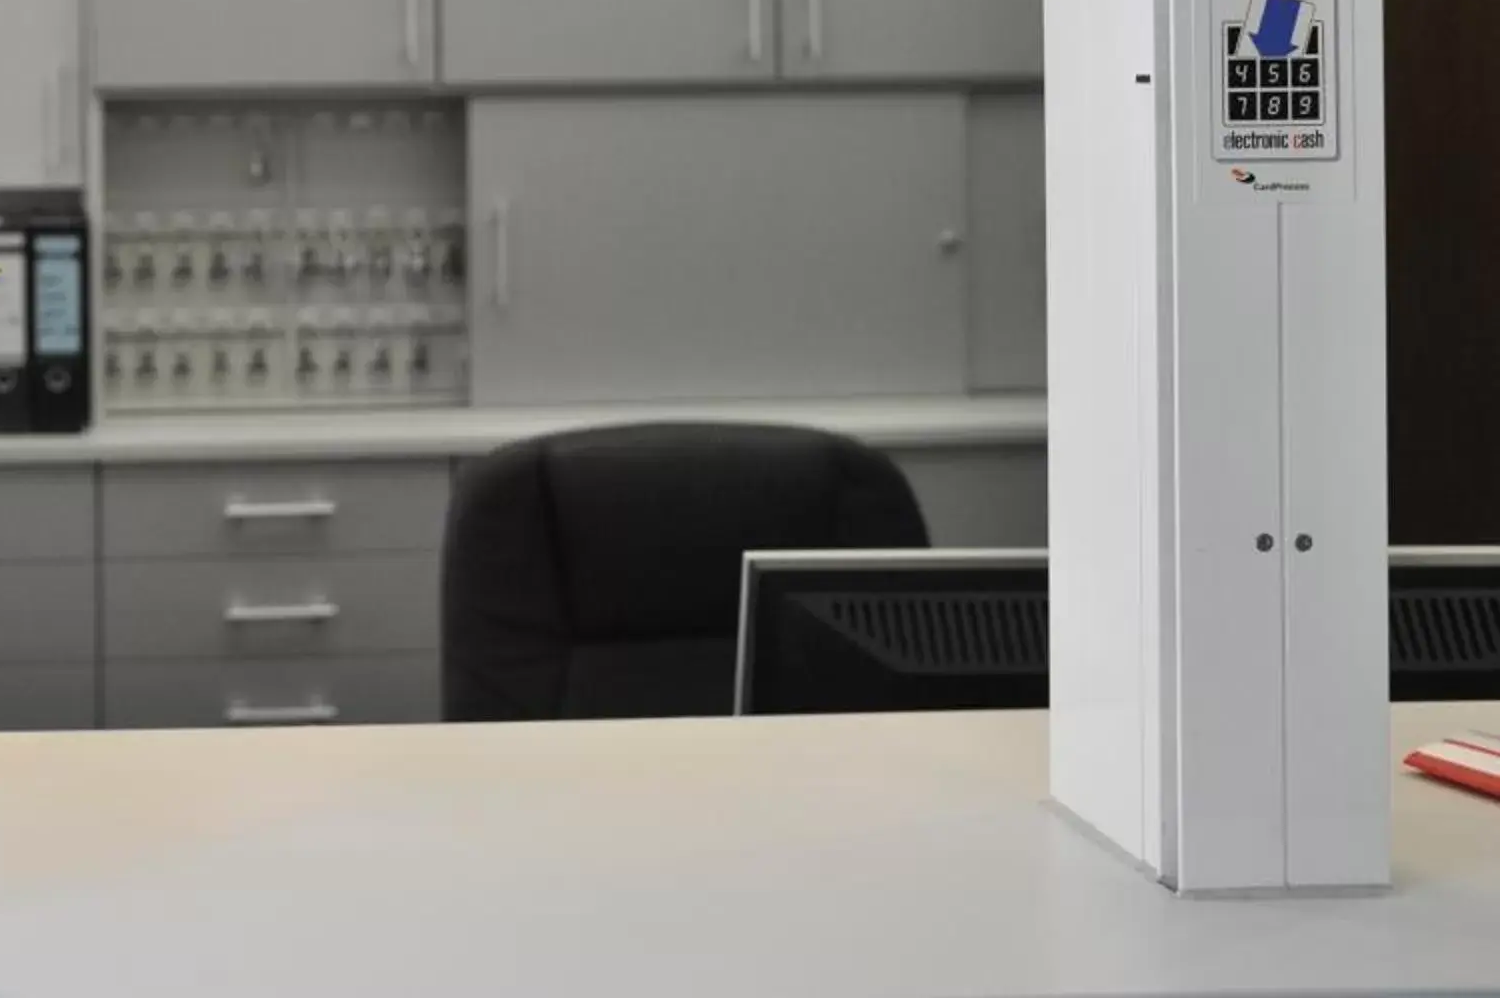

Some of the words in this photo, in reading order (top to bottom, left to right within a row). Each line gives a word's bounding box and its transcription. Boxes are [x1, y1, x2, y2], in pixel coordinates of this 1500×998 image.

[1235, 63, 1248, 83] 4
[1267, 63, 1280, 83] 5
[1299, 63, 1311, 83] 6
[1237, 96, 1248, 115] 7
[1267, 96, 1281, 115] 8
[1299, 95, 1311, 115] 9
[1223, 129, 1289, 150] electronic
[1293, 129, 1325, 149] cash
